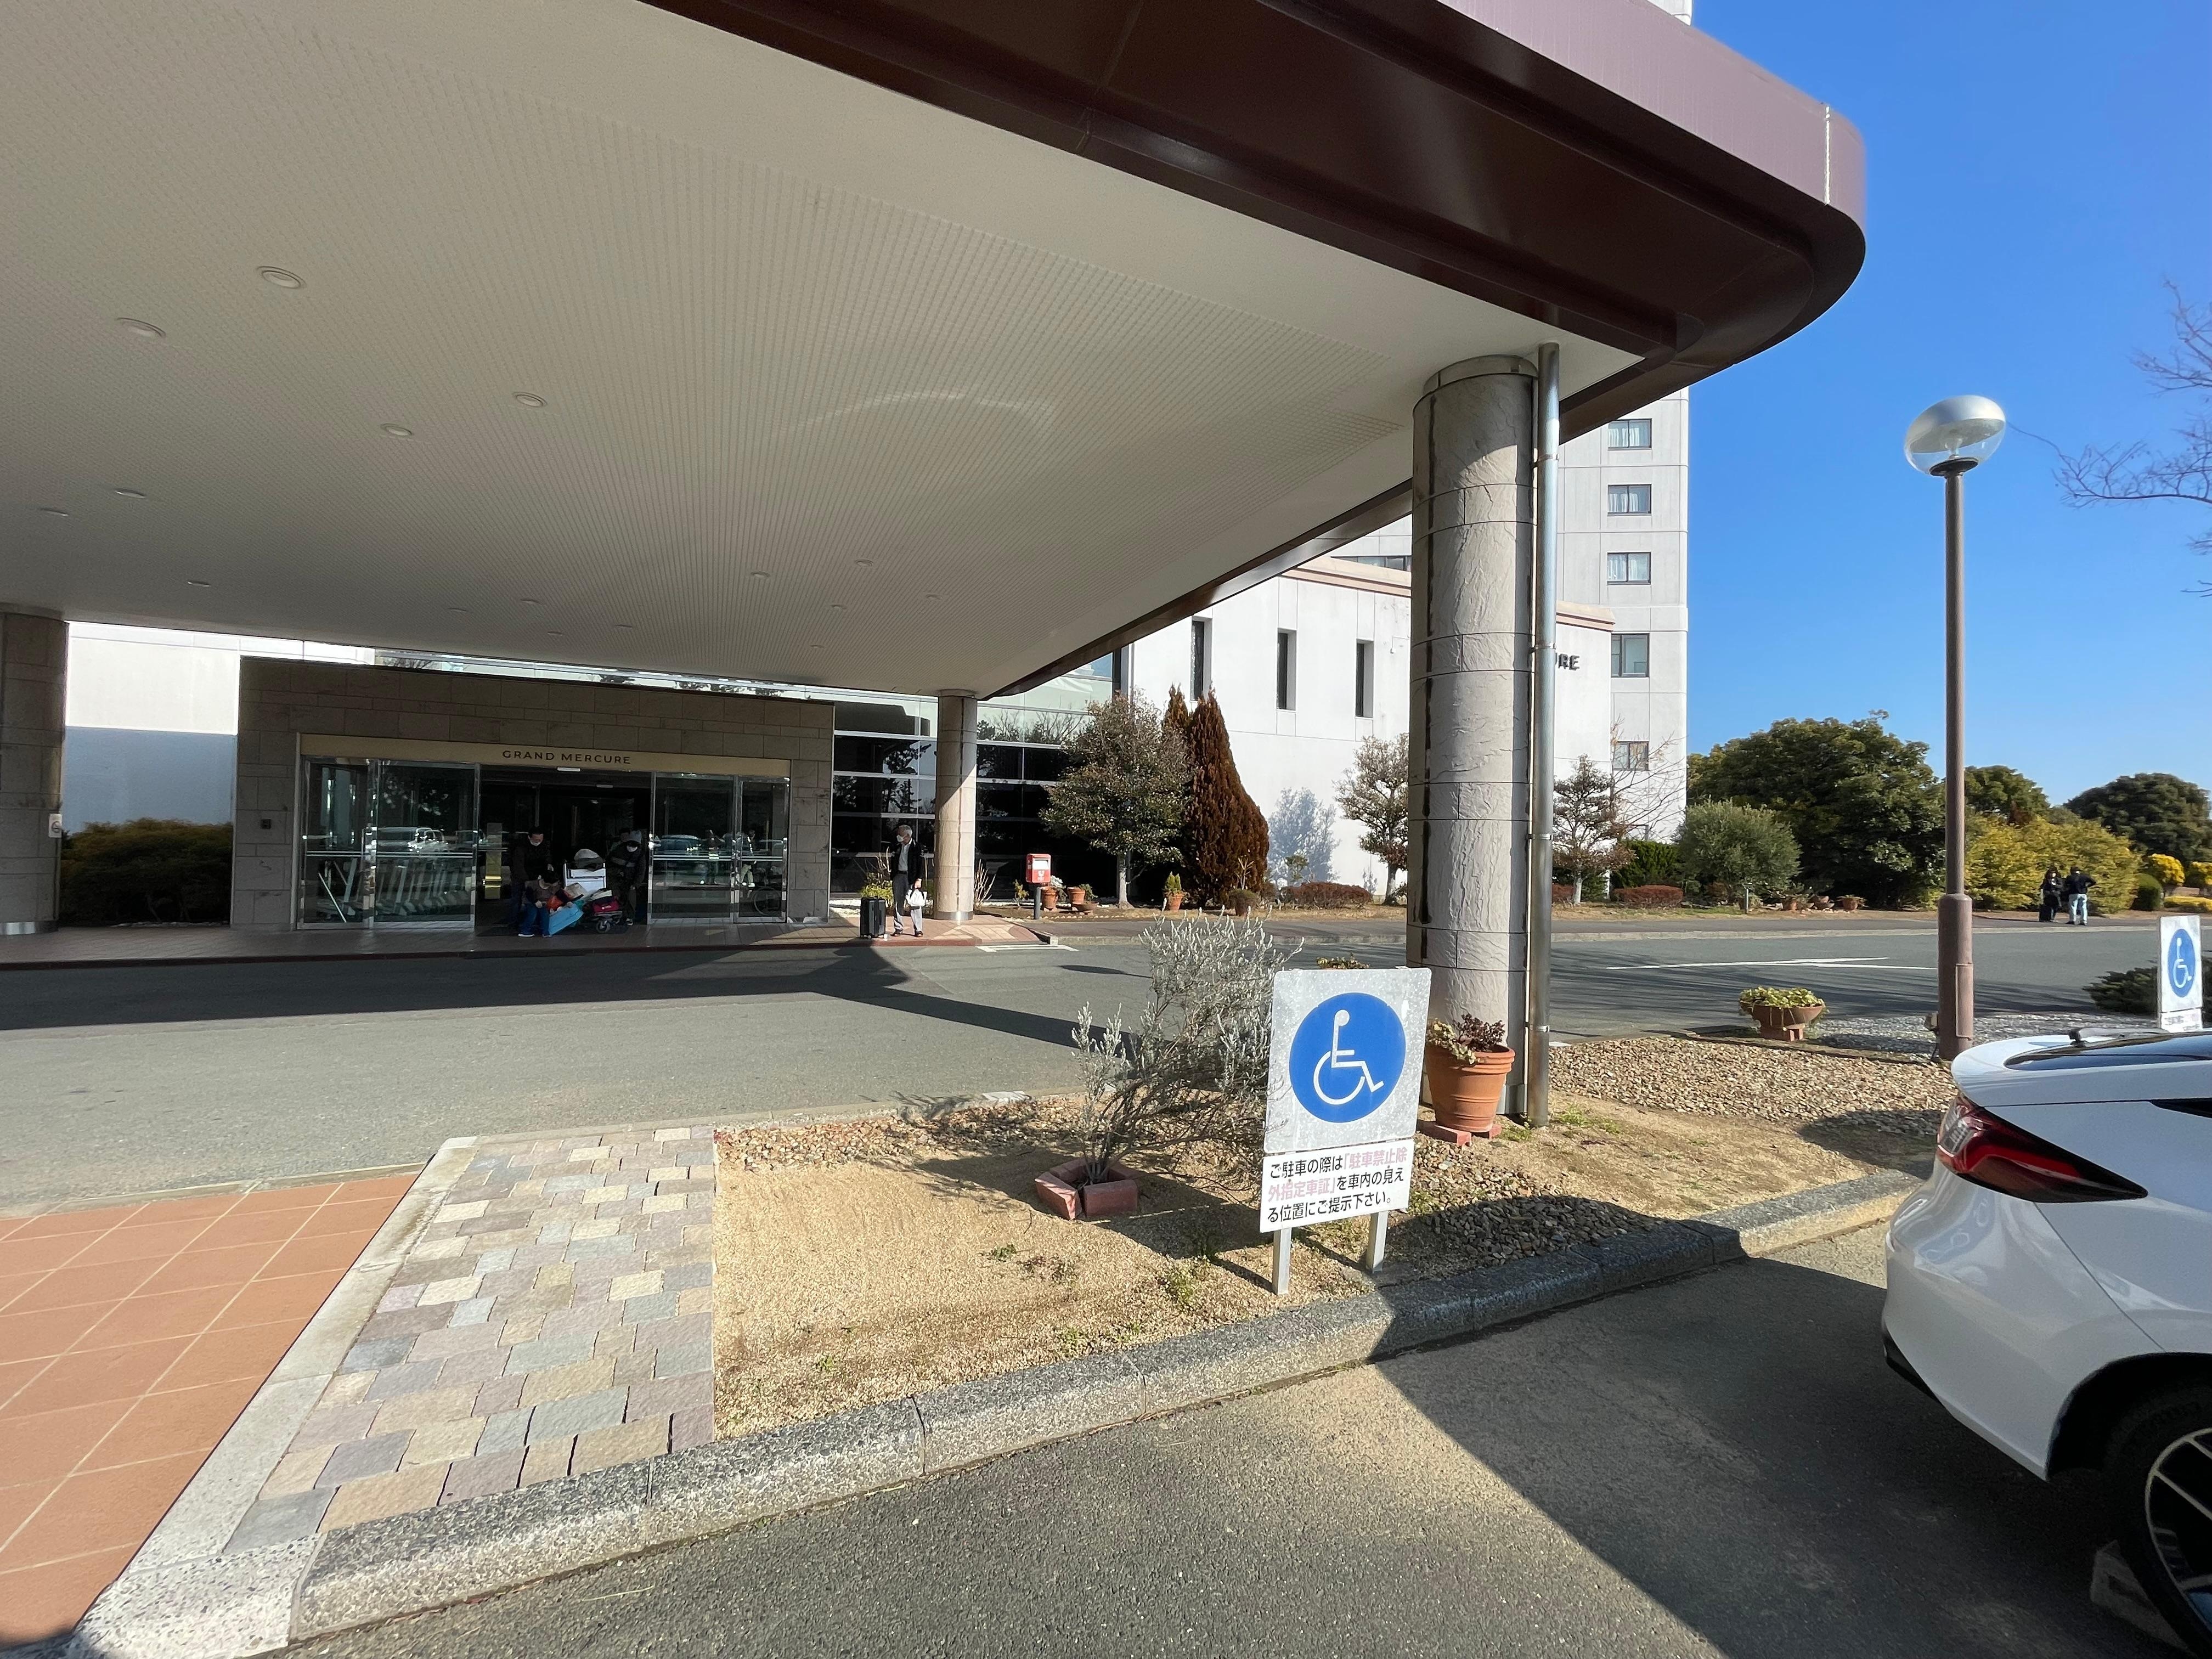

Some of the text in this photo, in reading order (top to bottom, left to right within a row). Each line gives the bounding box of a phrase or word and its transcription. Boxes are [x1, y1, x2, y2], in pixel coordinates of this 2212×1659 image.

[503, 750, 631, 764] GRAND MERCURE
[1270, 1146, 1408, 1178] ご駐車の際は「駐車禁止除
[1268, 1167, 1404, 1203] 外指定車証」を車内の見え
[1267, 1191, 1391, 1223] る位置にご提示下さい。
